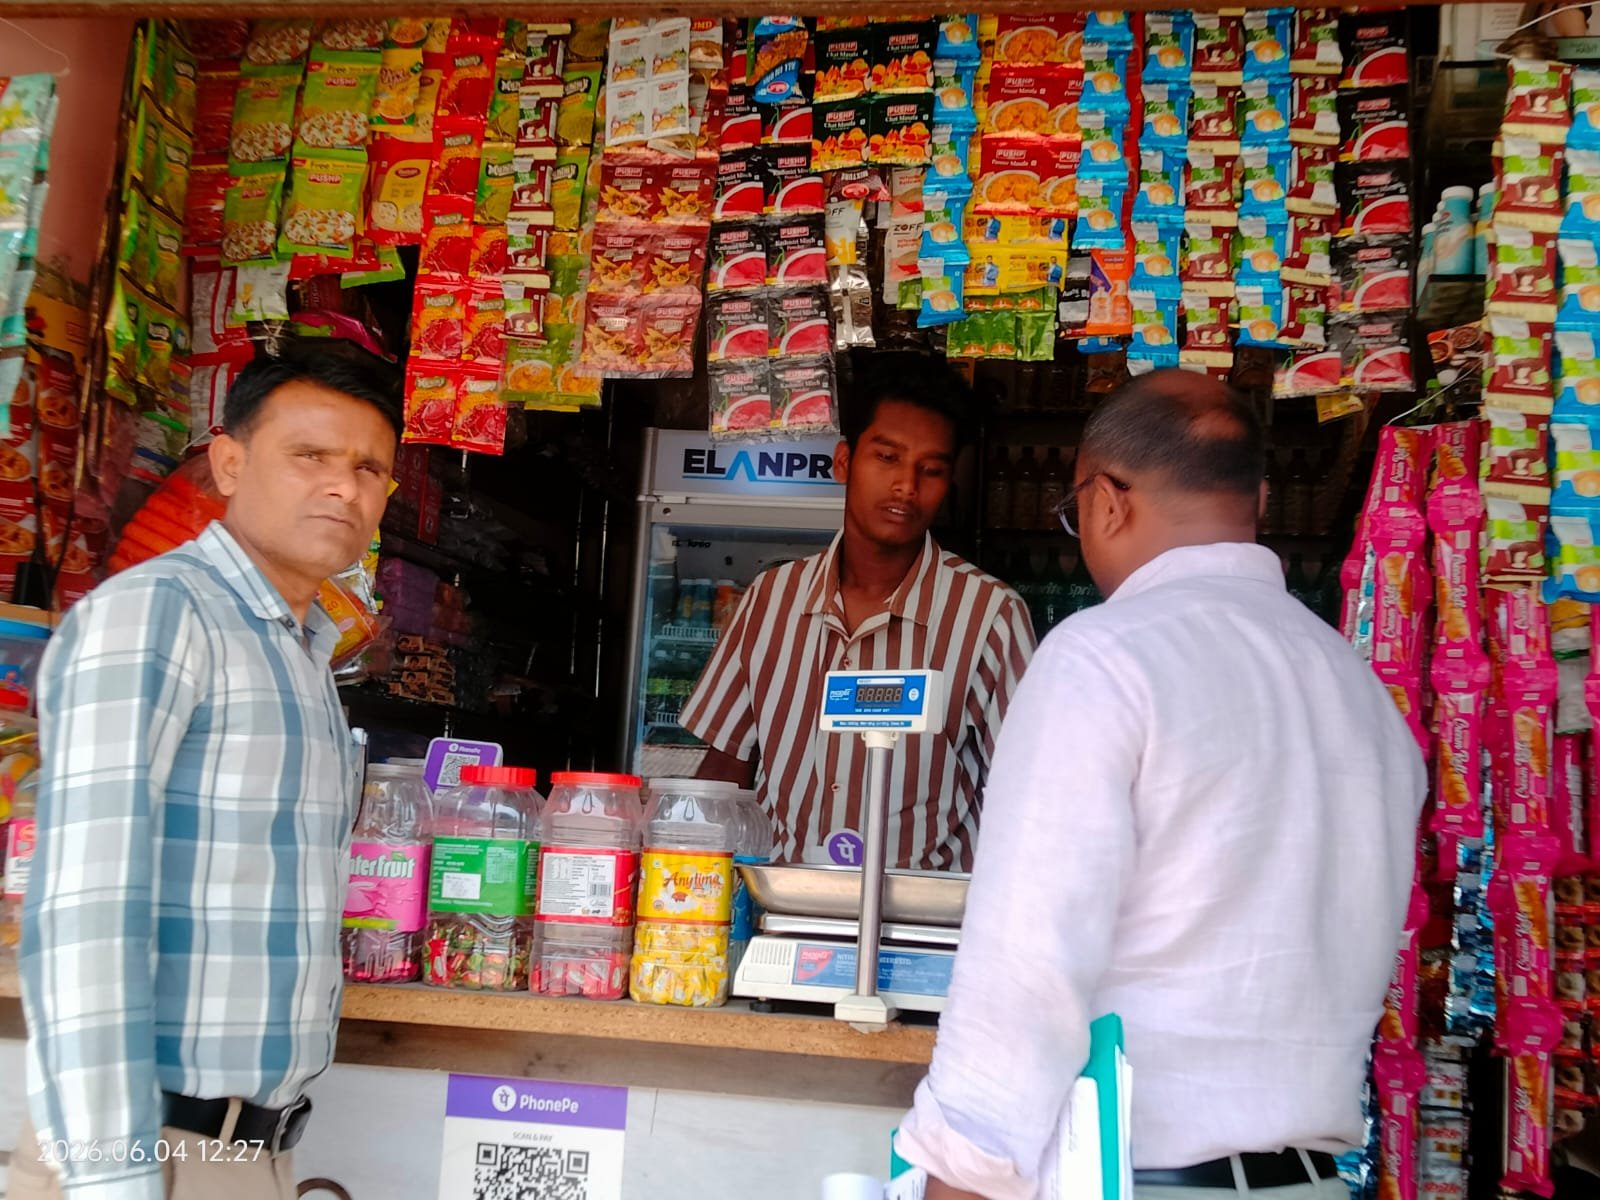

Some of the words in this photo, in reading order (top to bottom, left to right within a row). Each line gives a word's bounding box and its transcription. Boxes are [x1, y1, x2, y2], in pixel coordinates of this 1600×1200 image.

[693, 21, 713, 30] JMD
[889, 34, 918, 45] PUSHP
[829, 42, 857, 52] PUSHP
[1006, 78, 1033, 87] PUSHP
[728, 95, 744, 105] SHP
[887, 104, 917, 115] PUSHP
[826, 111, 854, 122] PUSHP
[997, 149, 1025, 159] PUSHP
[1060, 152, 1080, 162] PUS
[310, 161, 331, 170] Free
[719, 162, 746, 174] PUSHP
[778, 157, 806, 168] PUSHP
[615, 167, 642, 177] PUSHP
[672, 168, 700, 178] PUSHP
[796, 167, 810, 175] Mir
[309, 174, 341, 184] PUSHP
[718, 174, 735, 182] ashmiri
[825, 206, 847, 217] OFF
[780, 227, 809, 238] PUSHP
[894, 223, 924, 232] ZOFF
[607, 237, 635, 247] PUSHP
[720, 231, 748, 243] PUSHP
[664, 239, 692, 248] PUSHP
[722, 302, 750, 313] PUSHP
[783, 297, 812, 309] PUSHP
[724, 374, 753, 385] PUSHP
[785, 369, 814, 380] PUSHP
[683, 448, 833, 482] ELANPR
[1453, 717, 1470, 750] Cream
[1453, 750, 1470, 775] Roll
[350, 856, 416, 878] nterfruit
[519, 1094, 580, 1114] PhonePe
[513, 1131, 532, 1141] SCAN
[533, 1133, 538, 1141] &
[539, 1134, 553, 1143] PAY
